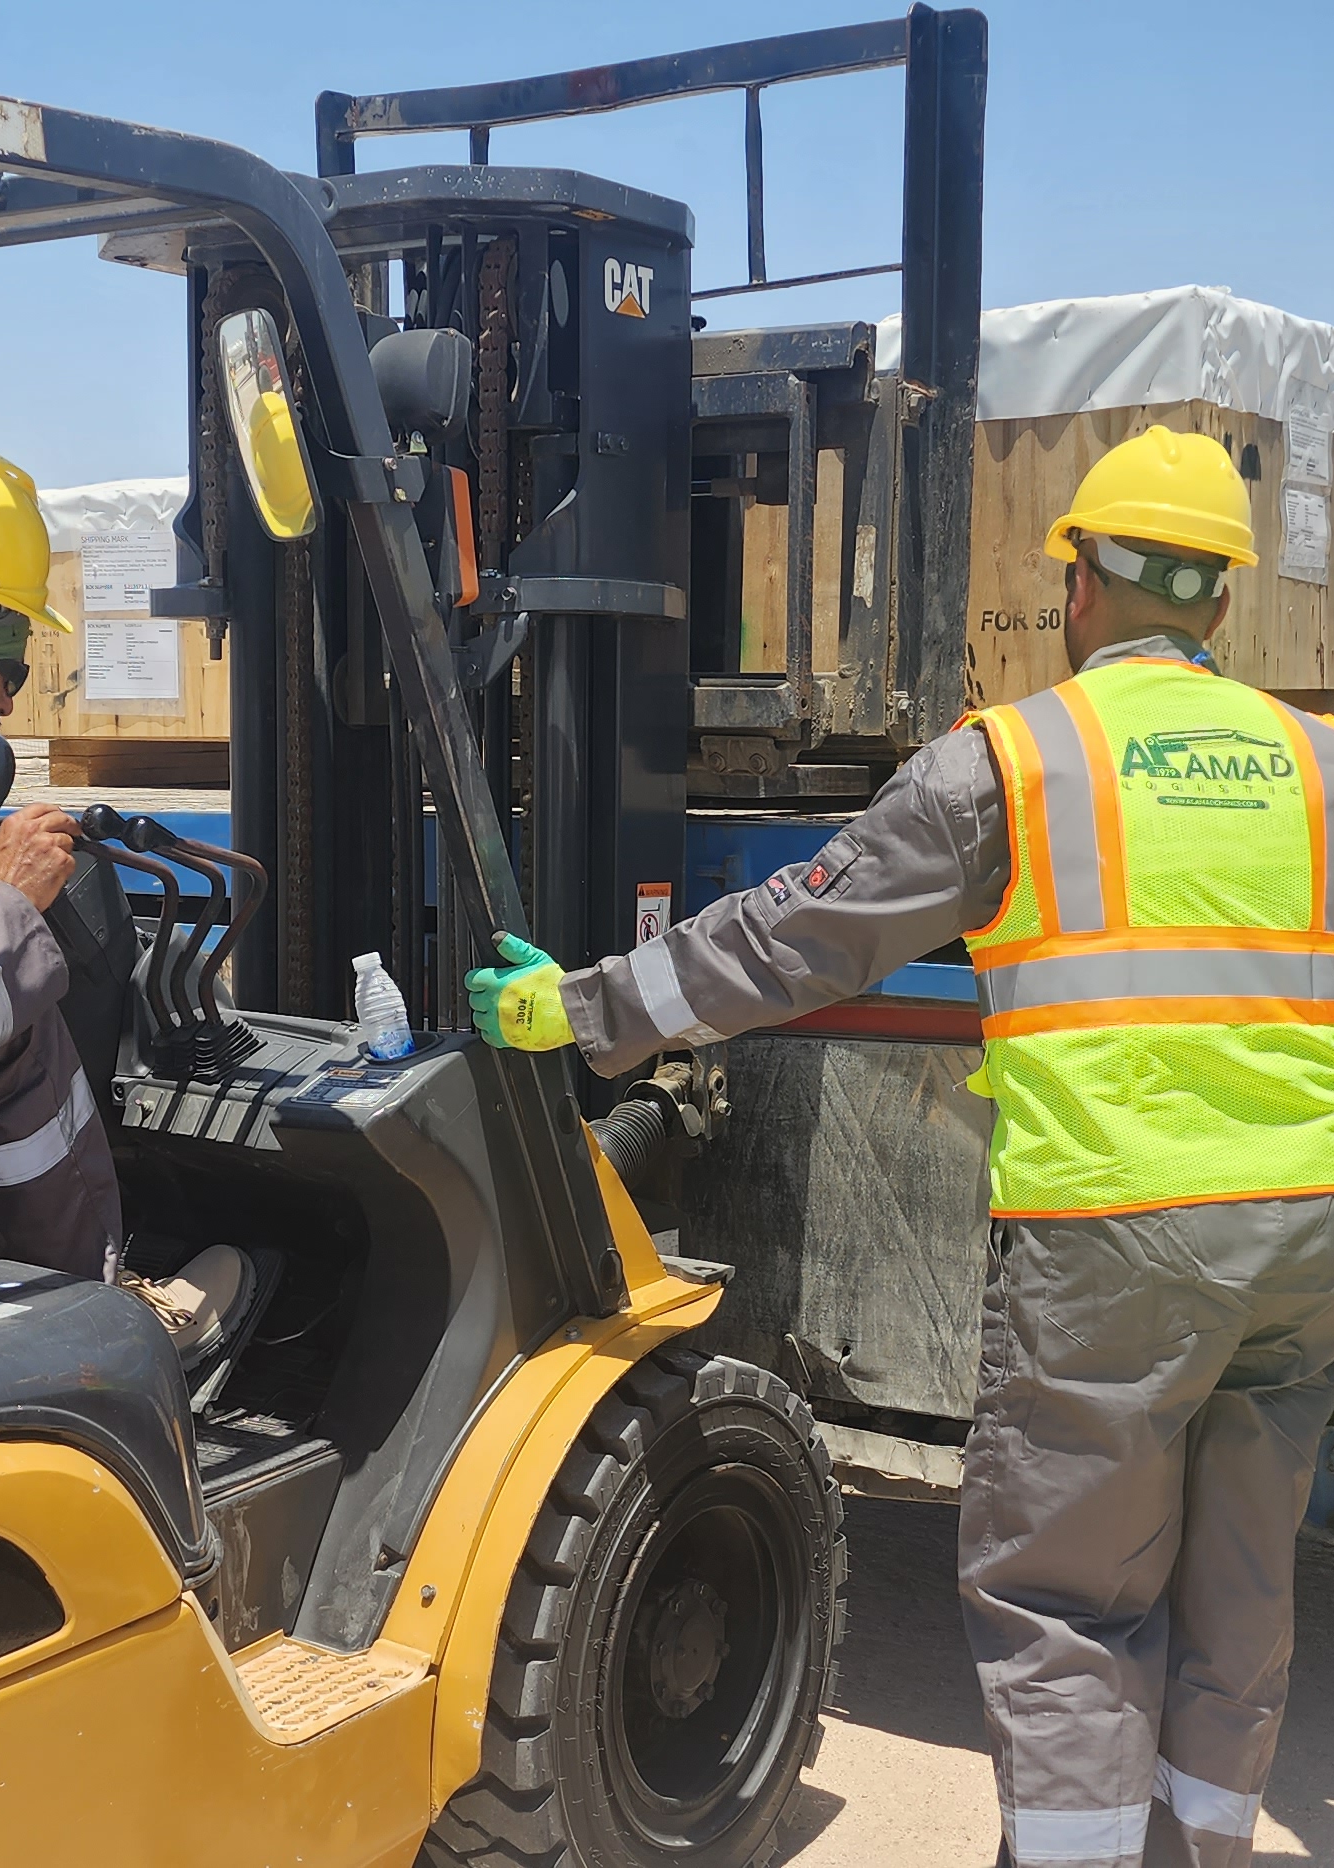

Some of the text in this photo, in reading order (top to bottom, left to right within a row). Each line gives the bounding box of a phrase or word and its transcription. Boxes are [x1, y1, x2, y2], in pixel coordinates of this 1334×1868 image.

[604, 256, 654, 316] CAT
[81, 535, 110, 544] SHIPPING
[111, 535, 129, 543] MARK
[980, 607, 1061, 632] FOR 50
[515, 997, 528, 1025] 300#
